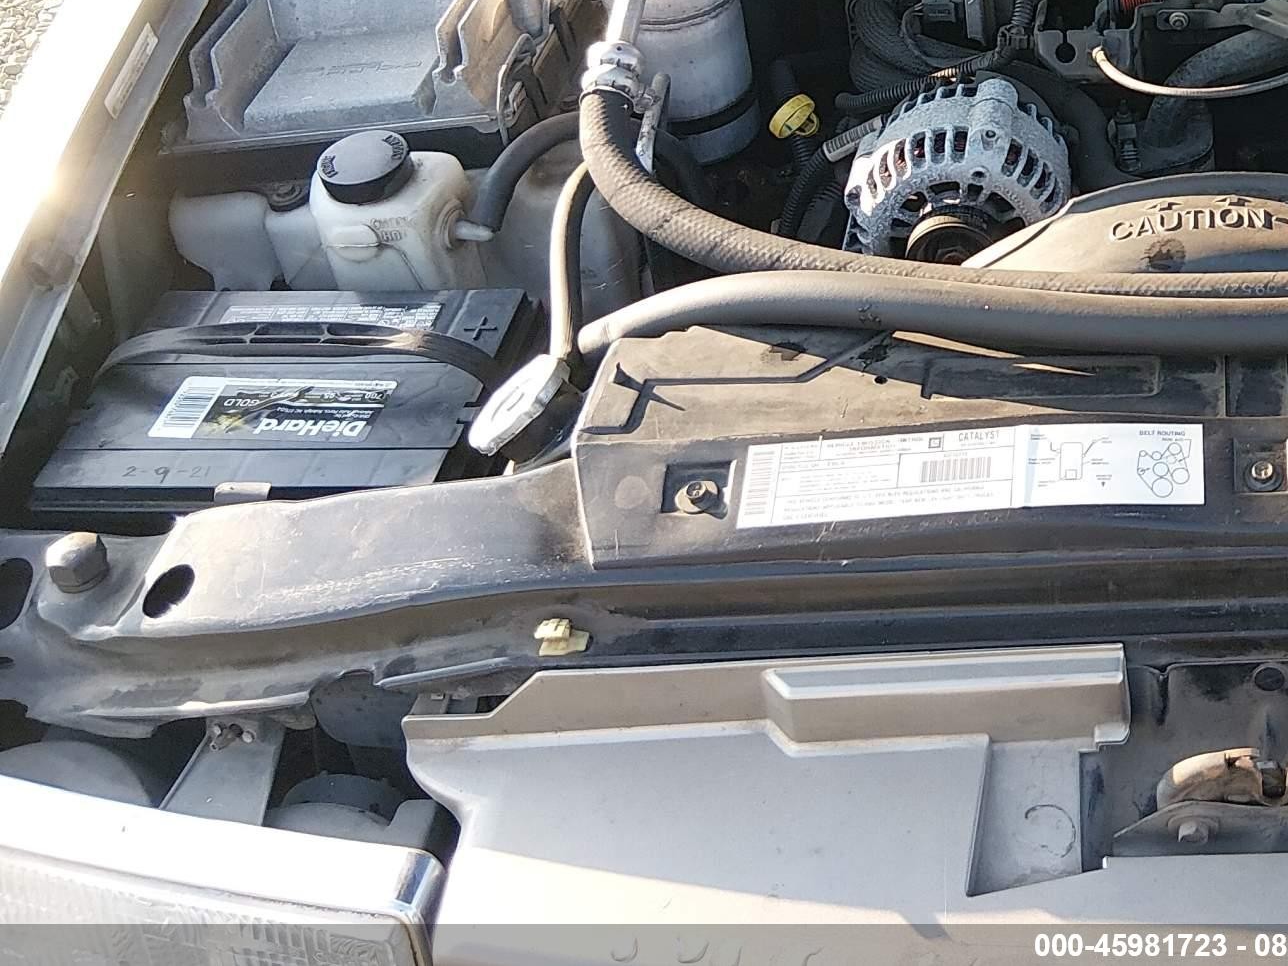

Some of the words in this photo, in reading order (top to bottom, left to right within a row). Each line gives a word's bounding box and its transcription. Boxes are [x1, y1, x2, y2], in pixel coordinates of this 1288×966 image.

[224, 399, 260, 407] GOLD
[252, 417, 368, 438] DieHard
[959, 430, 999, 441] CATALYST
